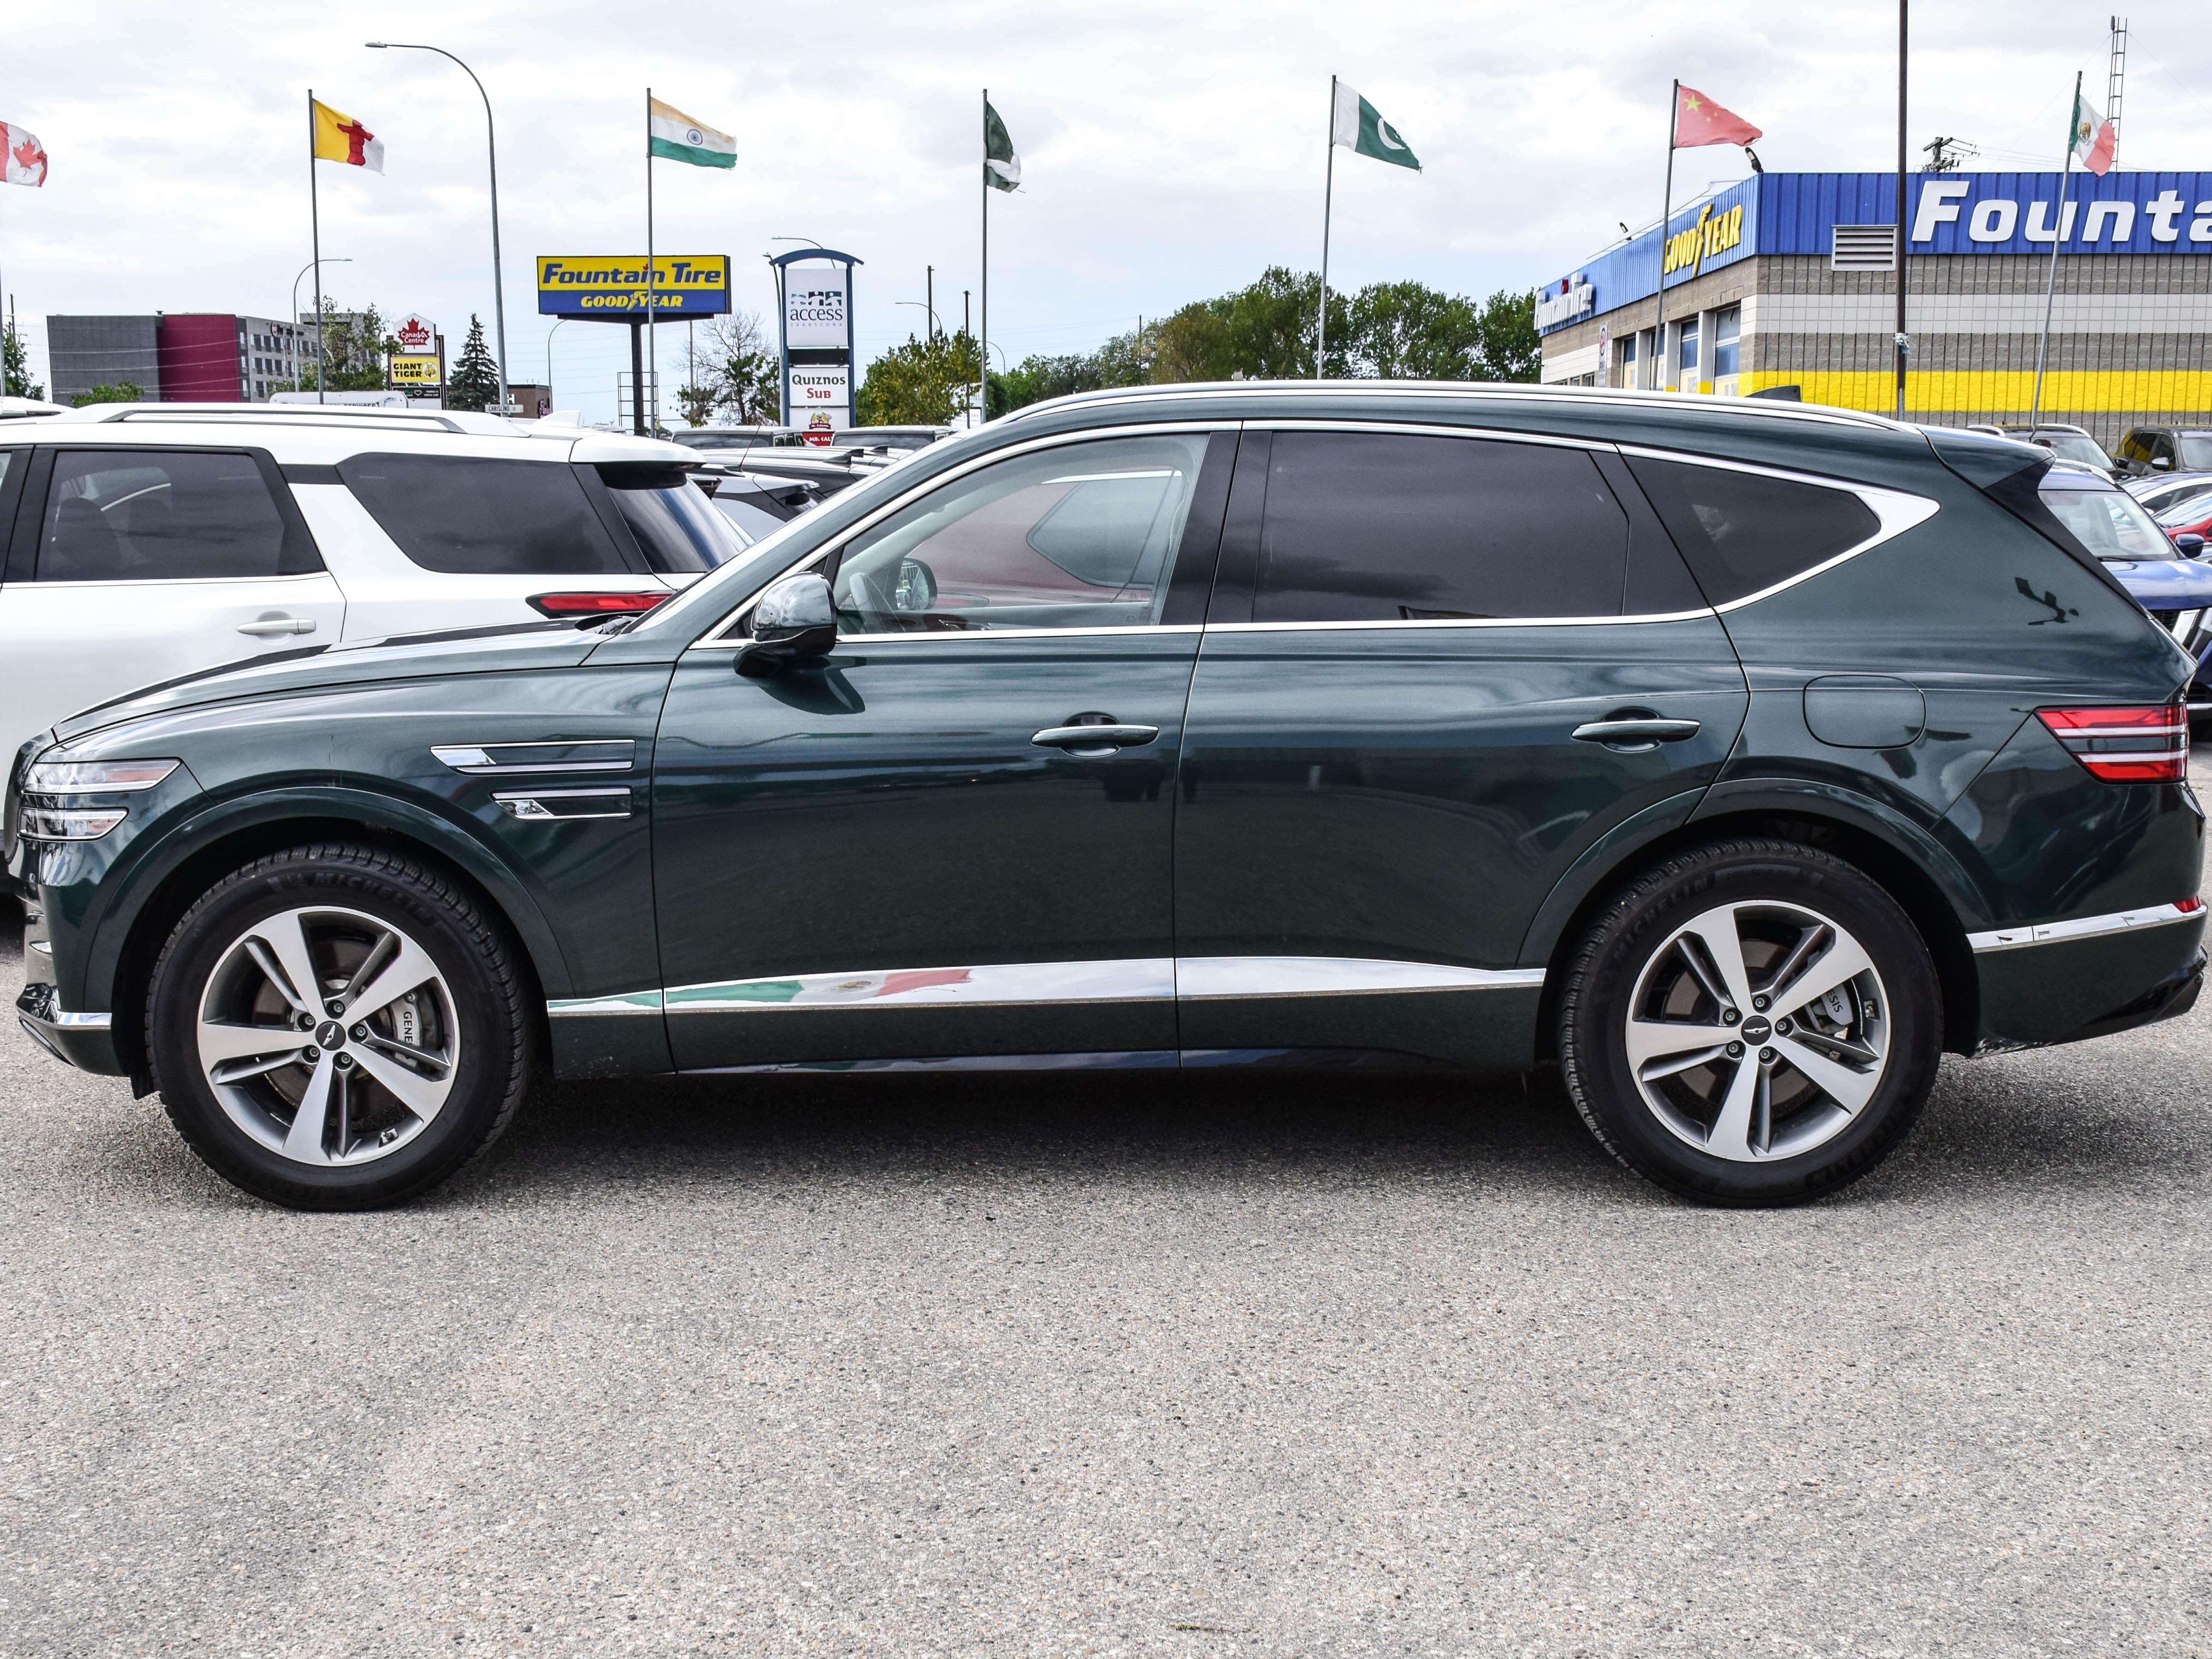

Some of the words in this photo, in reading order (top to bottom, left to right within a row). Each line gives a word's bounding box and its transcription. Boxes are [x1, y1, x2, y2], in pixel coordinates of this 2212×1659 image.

[543, 263, 665, 284] Fountain
[671, 262, 722, 283] Tire
[790, 309, 843, 321] access
[314, 872, 435, 925] MICHELIN
[1614, 876, 1709, 962] MICHELIN
[1826, 989, 1843, 1012] ESIS
[403, 1011, 413, 1044] GENE
